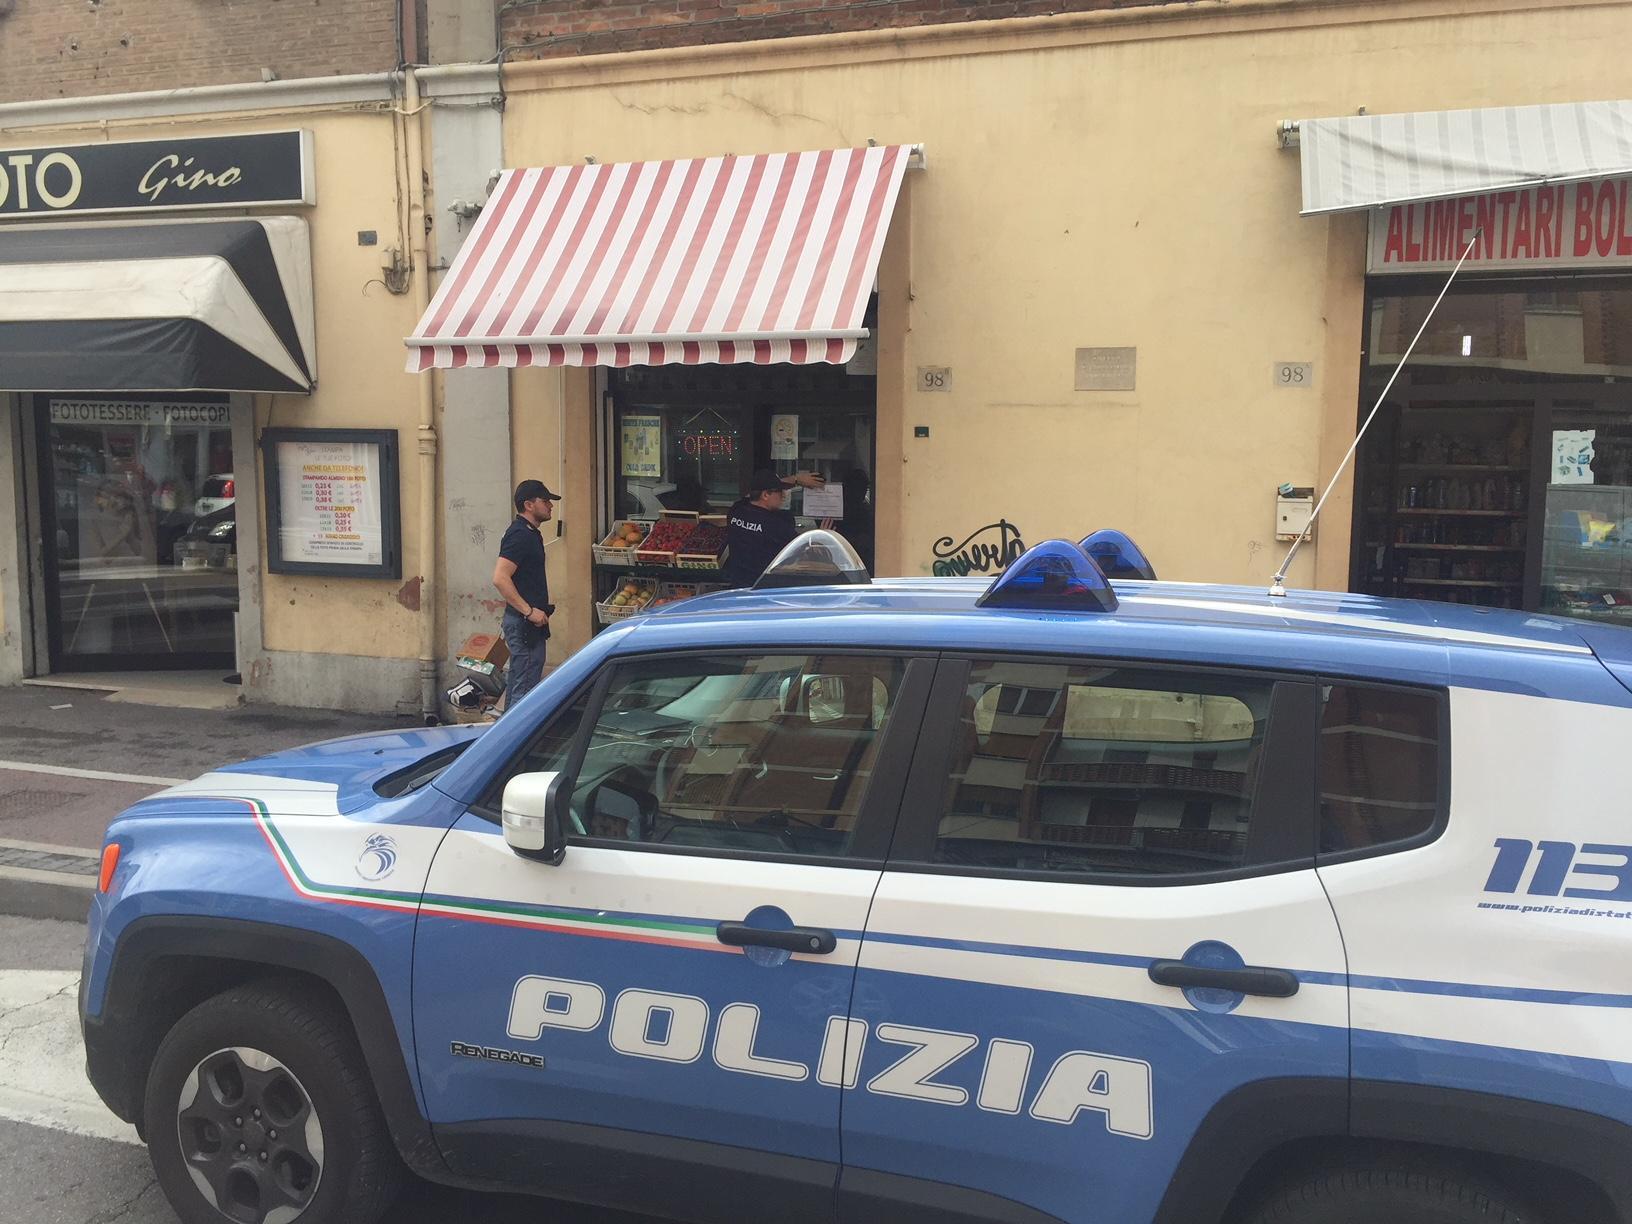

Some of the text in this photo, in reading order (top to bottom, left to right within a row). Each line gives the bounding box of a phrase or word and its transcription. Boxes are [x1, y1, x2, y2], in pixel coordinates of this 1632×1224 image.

[0, 152, 242, 210] TO Gino
[1383, 185, 1565, 263] ALIMENTARI
[924, 371, 944, 387] 98
[1281, 366, 1304, 383] 98
[51, 402, 151, 422] FOTOTESSERE
[684, 436, 732, 455] OPEN
[730, 517, 763, 532] POLIZIA
[1483, 837, 1632, 903] 113
[449, 1040, 545, 1068] RENEGADE
[506, 973, 1155, 1141] POLIZIA
